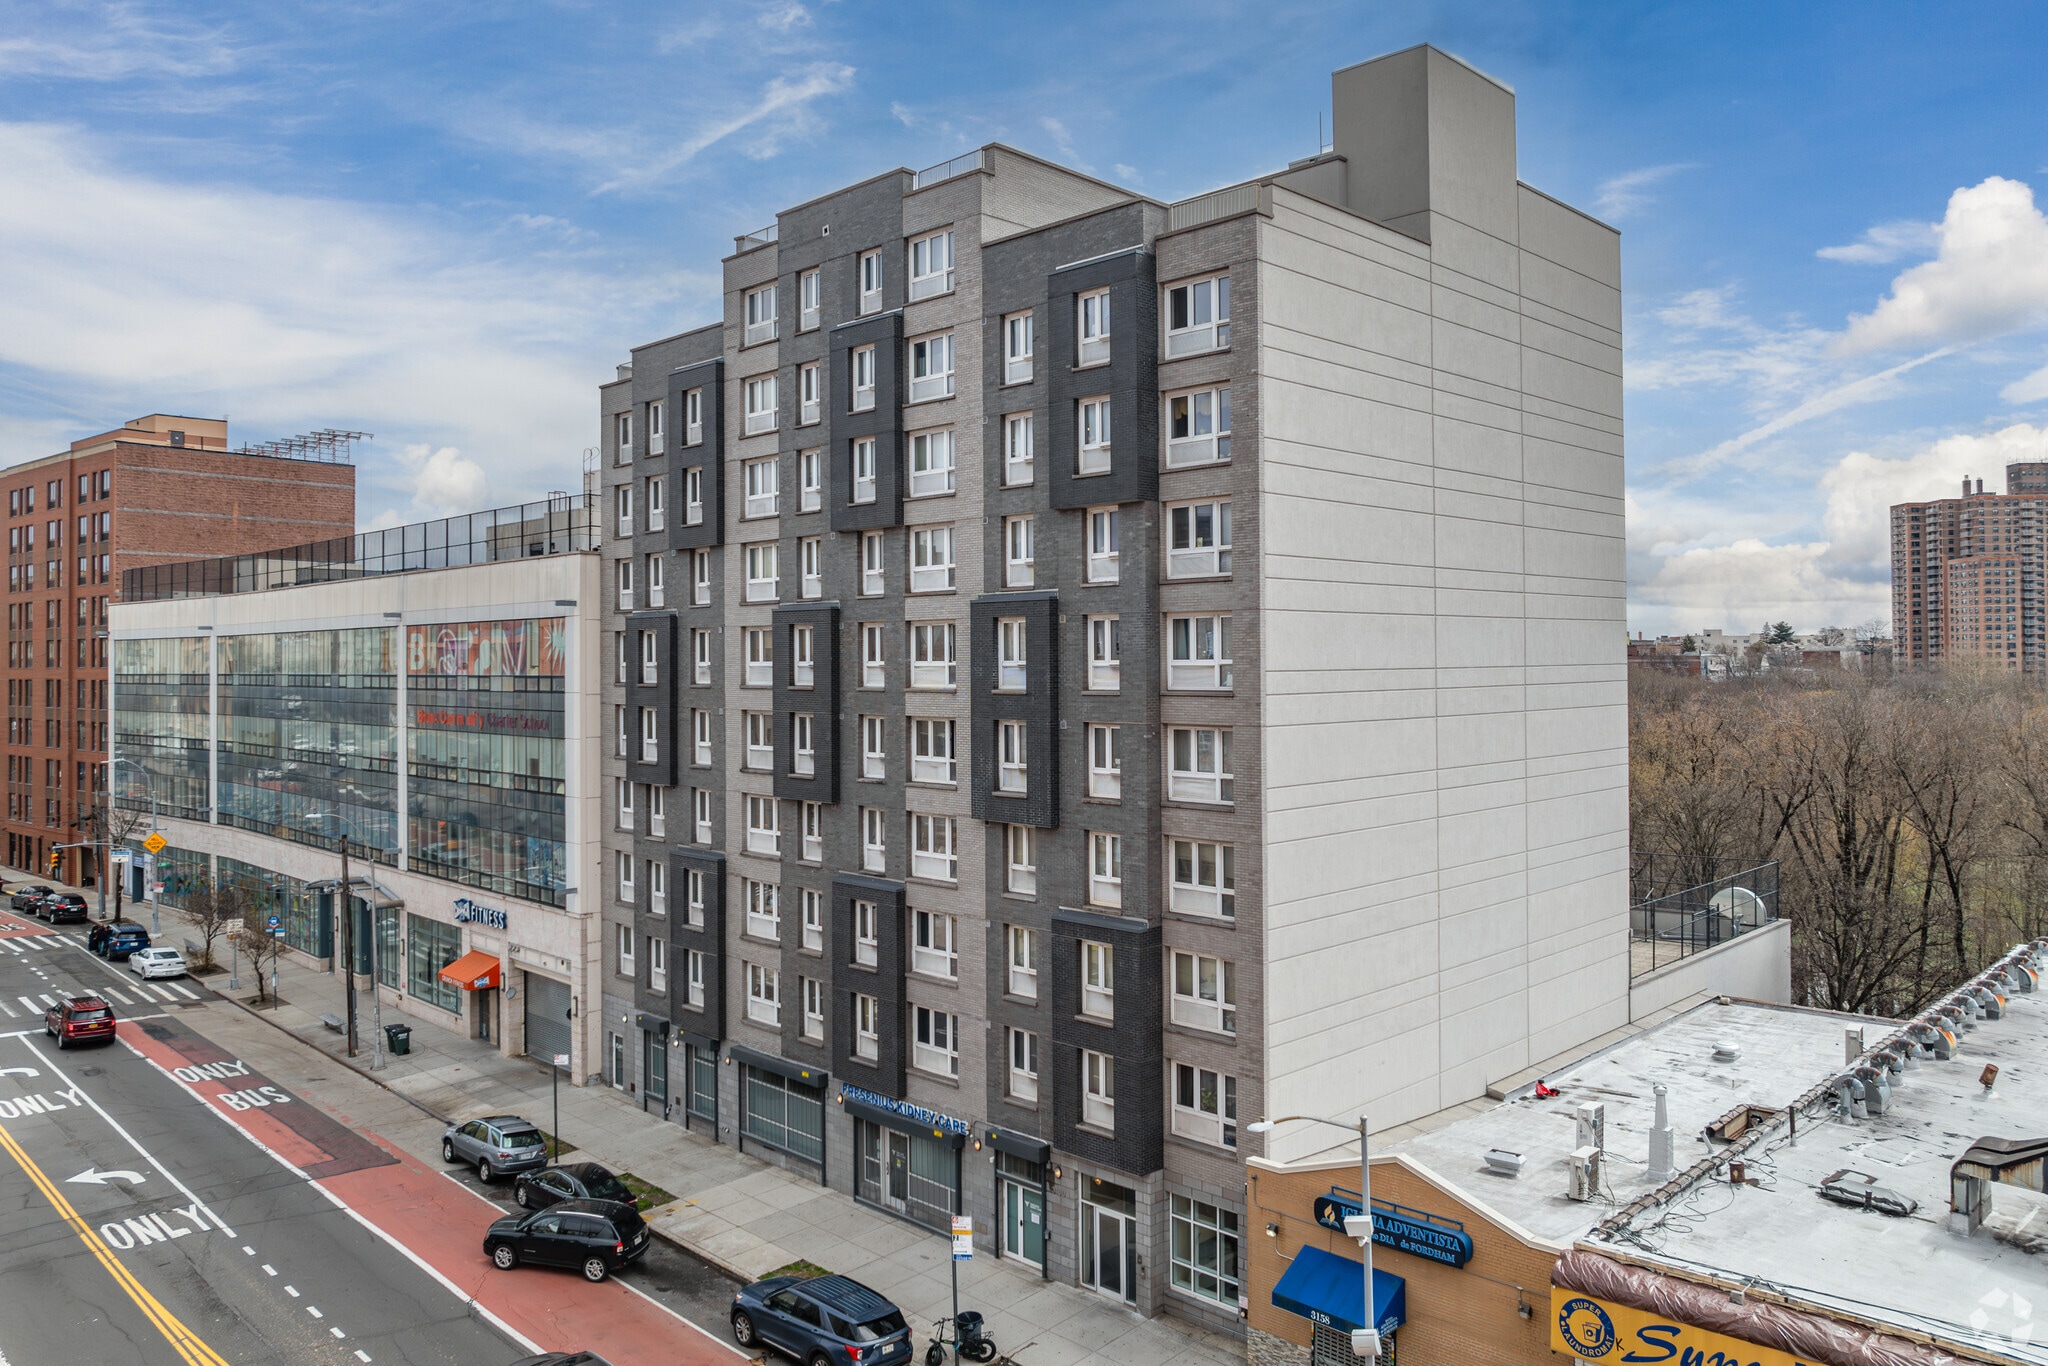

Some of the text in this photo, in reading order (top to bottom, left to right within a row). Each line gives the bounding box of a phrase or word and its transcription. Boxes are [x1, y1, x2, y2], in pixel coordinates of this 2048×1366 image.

[0, 923, 27, 931] US
[471, 905, 506, 930] FITNESS
[173, 1060, 250, 1083] ONLY
[0, 1088, 84, 1119] ONLY
[216, 1086, 291, 1111] BUS
[842, 1082, 969, 1136] FRESENIUS KIDNEY CARE
[100, 1204, 211, 1249] ONLY
[1385, 1219, 1461, 1252] ADVENTISTA
[1379, 1232, 1396, 1246] DIA
[1400, 1239, 1410, 1249] de
[1409, 1242, 1456, 1263] FORDHAM
[1310, 1310, 1331, 1325] 3158
[1571, 1301, 1602, 1317] SUPER
[1561, 1326, 1614, 1357] LAUNDROMAT
